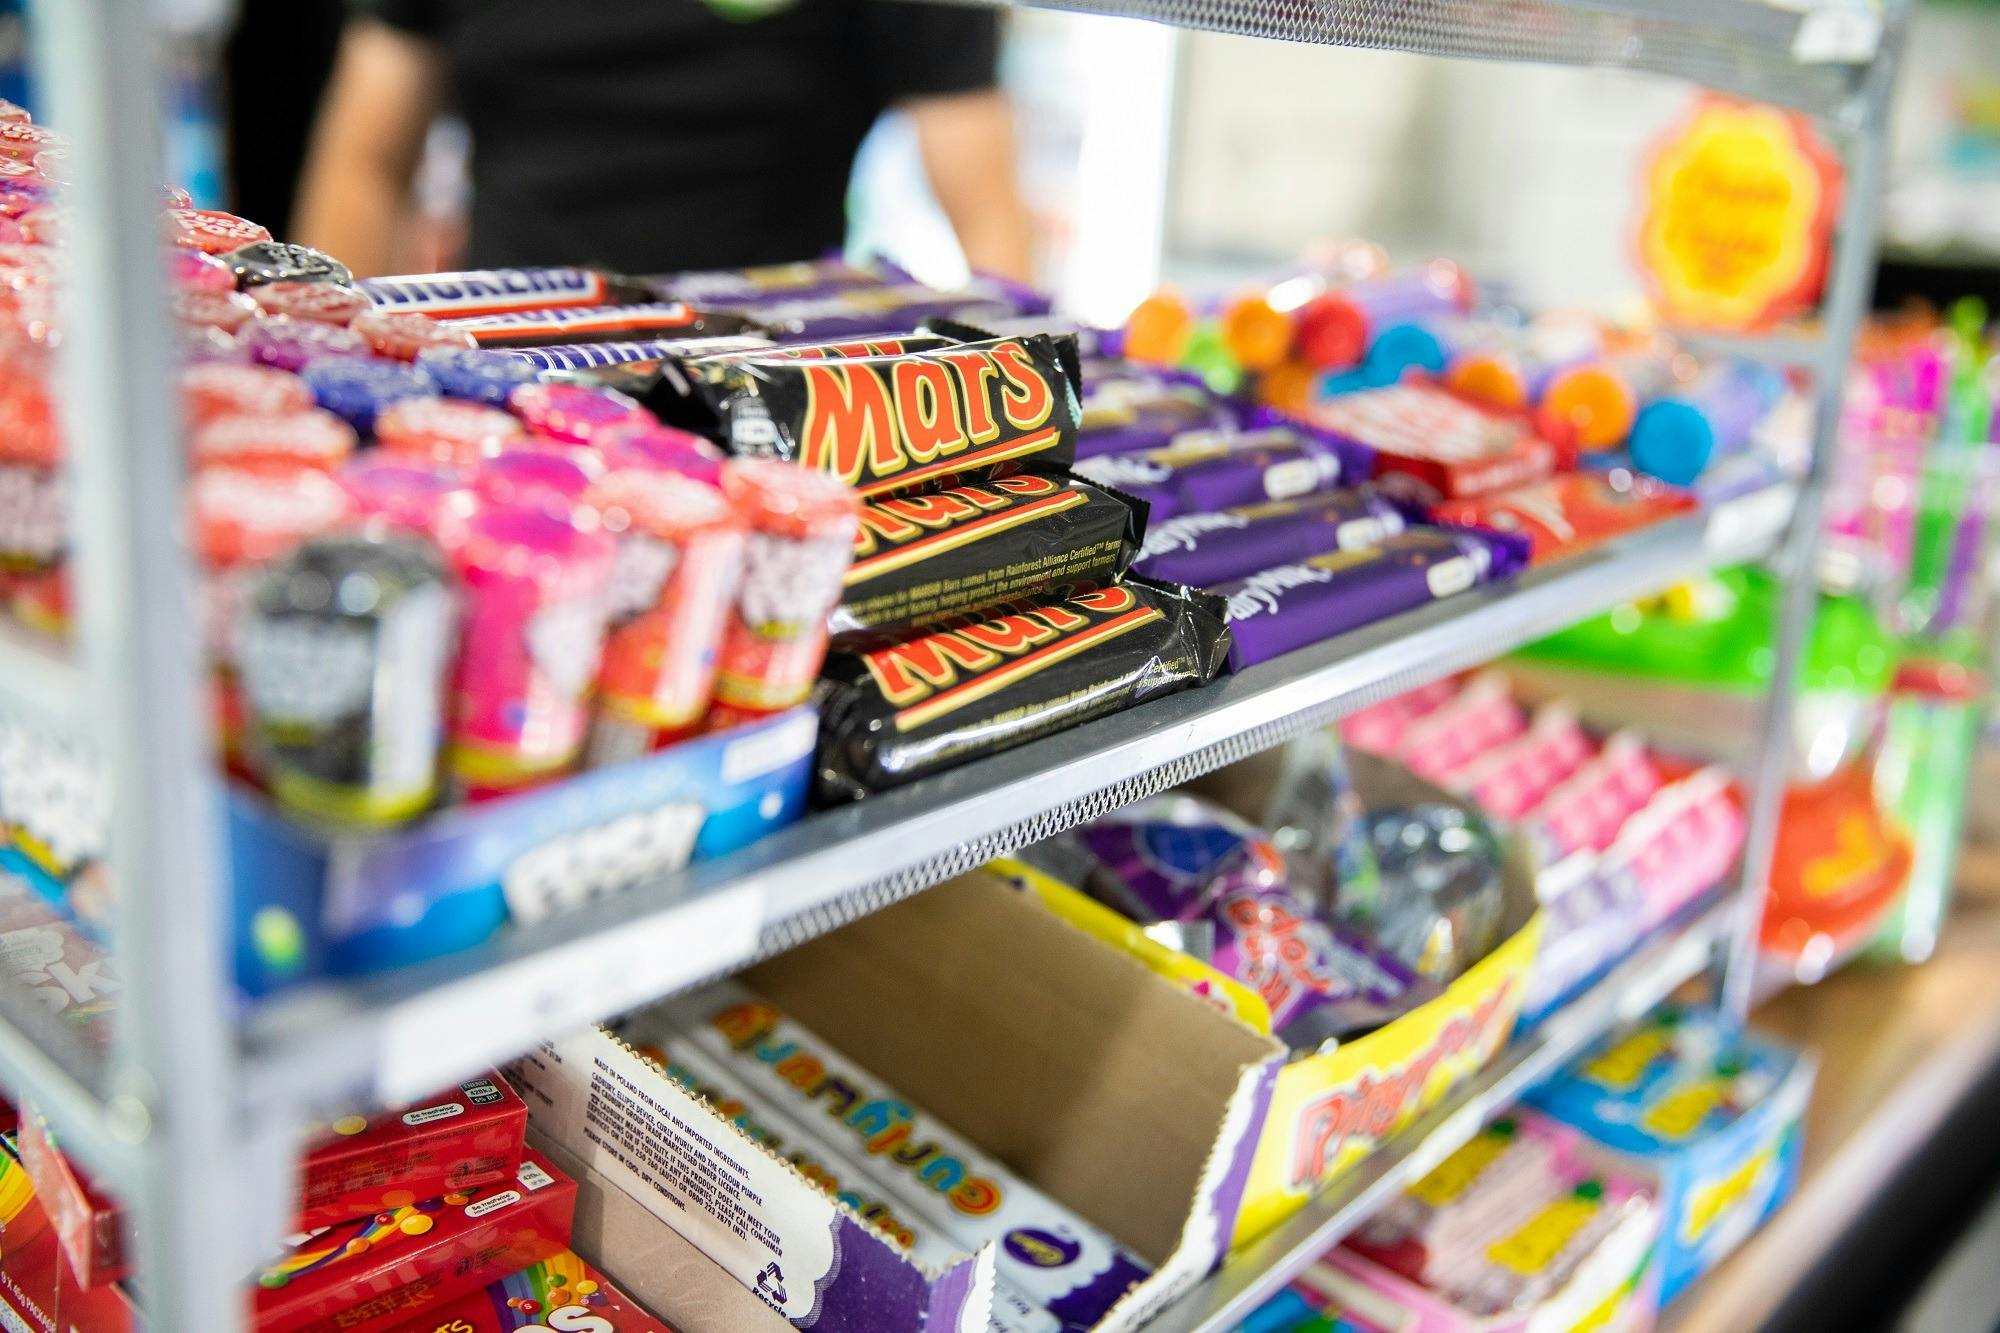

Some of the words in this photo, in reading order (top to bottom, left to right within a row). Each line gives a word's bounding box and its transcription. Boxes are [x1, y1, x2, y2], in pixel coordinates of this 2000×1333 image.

[799, 341, 1054, 486] Mars
[1006, 559, 1042, 577] Rainforest
[1042, 553, 1069, 568] Alliance
[1009, 570, 1051, 587] environment
[1051, 565, 1066, 577] and
[1066, 559, 1091, 575] support
[1091, 554, 1116, 568] farmers
[586, 1109, 610, 1134] SERVICES
[610, 1129, 619, 1141] ON
[620, 1136, 635, 1152] 1800
[635, 1148, 646, 1161] 250
[647, 1157, 658, 1171] 260
[658, 1165, 678, 1187] (AUST)
[678, 1182, 688, 1194] OR
[688, 1190, 704, 1206] 0800
[716, 1211, 732, 1228] 2879
[594, 1057, 609, 1073] MADE
[610, 1068, 616, 1079] IN
[617, 1074, 638, 1094] POLAND
[638, 1091, 654, 1108] FROM
[654, 1102, 671, 1120] LOCAL
[672, 1116, 684, 1130] AND
[684, 1124, 713, 1151] IMPORTED
[714, 1148, 750, 1180] INGREDIENTS.
[599, 1099, 625, 1123] CADBURY
[625, 1121, 644, 1139] MEANS
[645, 1135, 669, 1160] QUALITY.
[670, 1154, 676, 1164] IF
[677, 1159, 690, 1175] THIS
[690, 1170, 717, 1195] PRODUCT
[718, 1190, 733, 1207] DOES
[733, 1204, 747, 1218] NOT
[746, 1214, 763, 1231] MEET
[763, 1224, 781, 1245] YOUR
[601, 1088, 625, 1112] CADBURY
[625, 1107, 645, 1128] GROUP
[645, 1122, 661, 1140] TRADE
[662, 1133, 682, 1155] MARKS
[683, 1151, 698, 1166] USED
[698, 1163, 717, 1181] UNDER
[717, 1177, 741, 1201] LICENCE.
[602, 1140, 618, 1158] STORE
[618, 1154, 625, 1163] IN
[641, 1172, 653, 1185] DRY
[653, 1181, 687, 1212] CONDITIONS.
[617, 1089, 635, 1110] ELLIPSE
[636, 1106, 655, 1126] DEVICE,
[656, 1121, 673, 1138] CURLY
[674, 1133, 693, 1153] WURLY
[693, 1150, 706, 1163] AND
[707, 1160, 718, 1171] THE
[718, 1167, 741, 1190] COLOUR
[741, 1185, 763, 1207] PURPLE
[587, 1100, 624, 1135] EXPECTATIONS
[625, 1131, 634, 1142] OR
[634, 1137, 640, 1146] IF
[641, 1142, 653, 1156] YOU
[653, 1151, 669, 1168] HAVE
[669, 1164, 682, 1178] ANY
[682, 1174, 713, 1203] ENQUIRIES,
[714, 1199, 736, 1220] PLEASE
[735, 1214, 750, 1231] CALL
[750, 1227, 783, 1257] CONSUMER
[752, 1286, 787, 1318] Recycle
